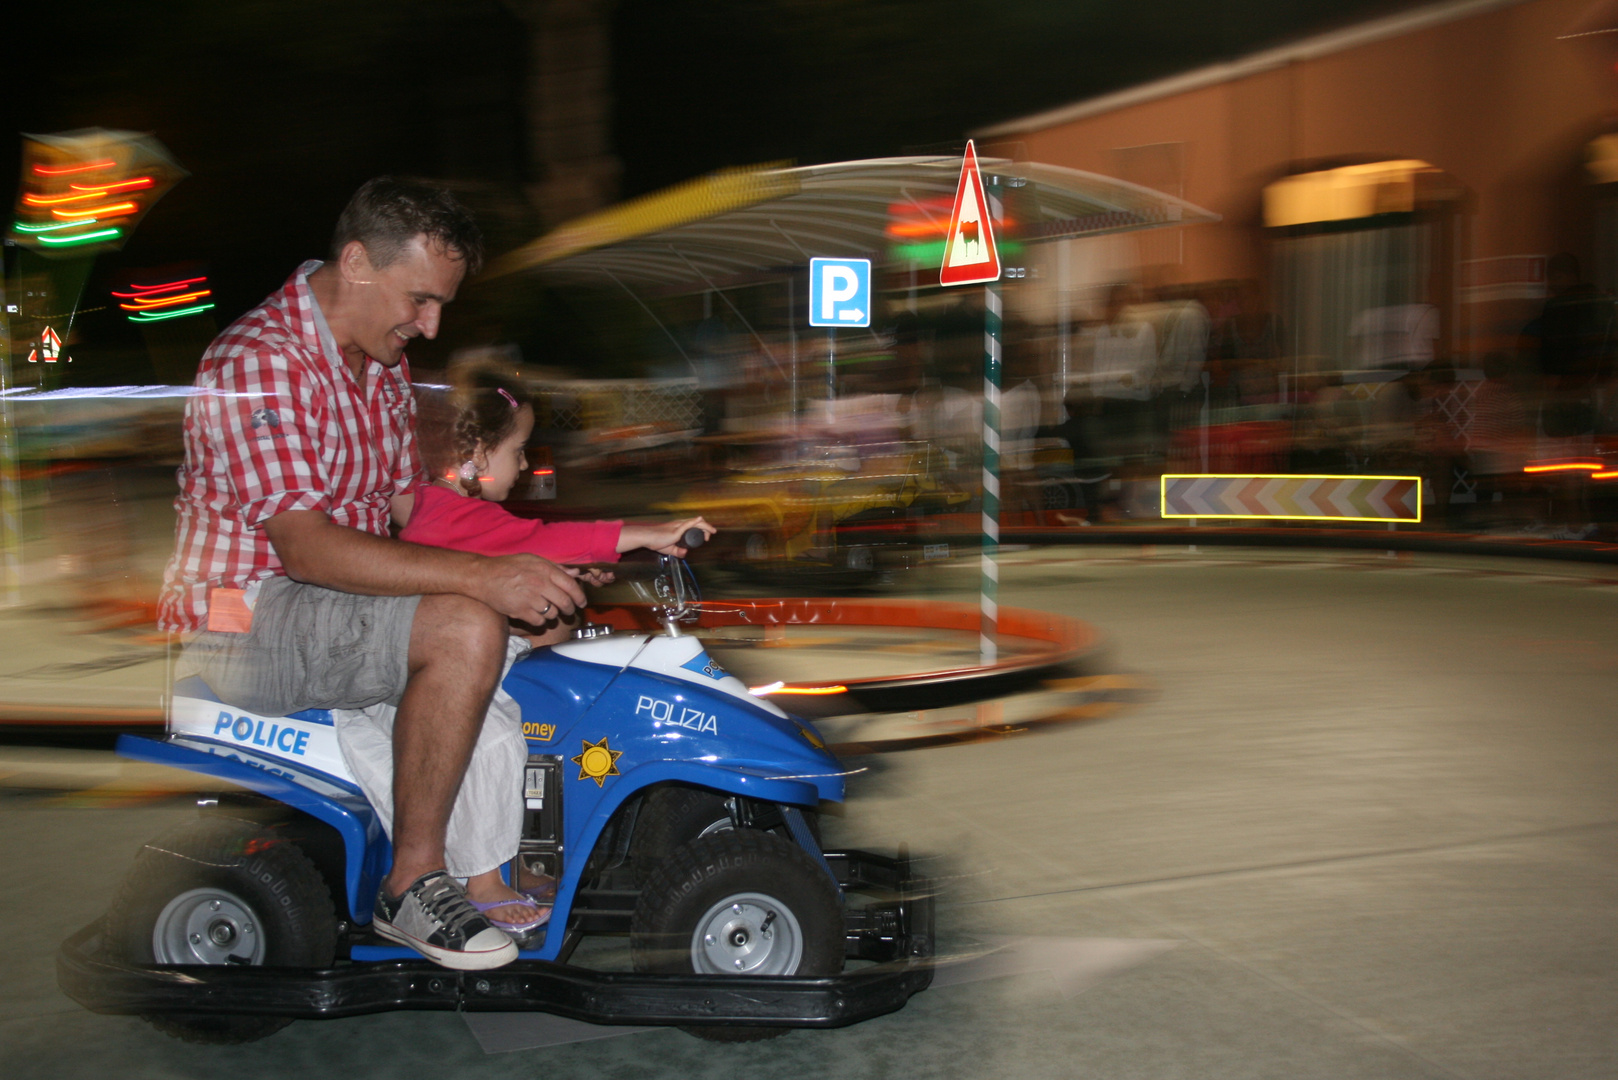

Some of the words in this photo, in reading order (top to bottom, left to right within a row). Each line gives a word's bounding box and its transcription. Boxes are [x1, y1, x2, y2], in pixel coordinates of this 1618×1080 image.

[822, 265, 859, 320] P
[213, 711, 311, 756] POLICE
[635, 695, 718, 736] POLIZIA
